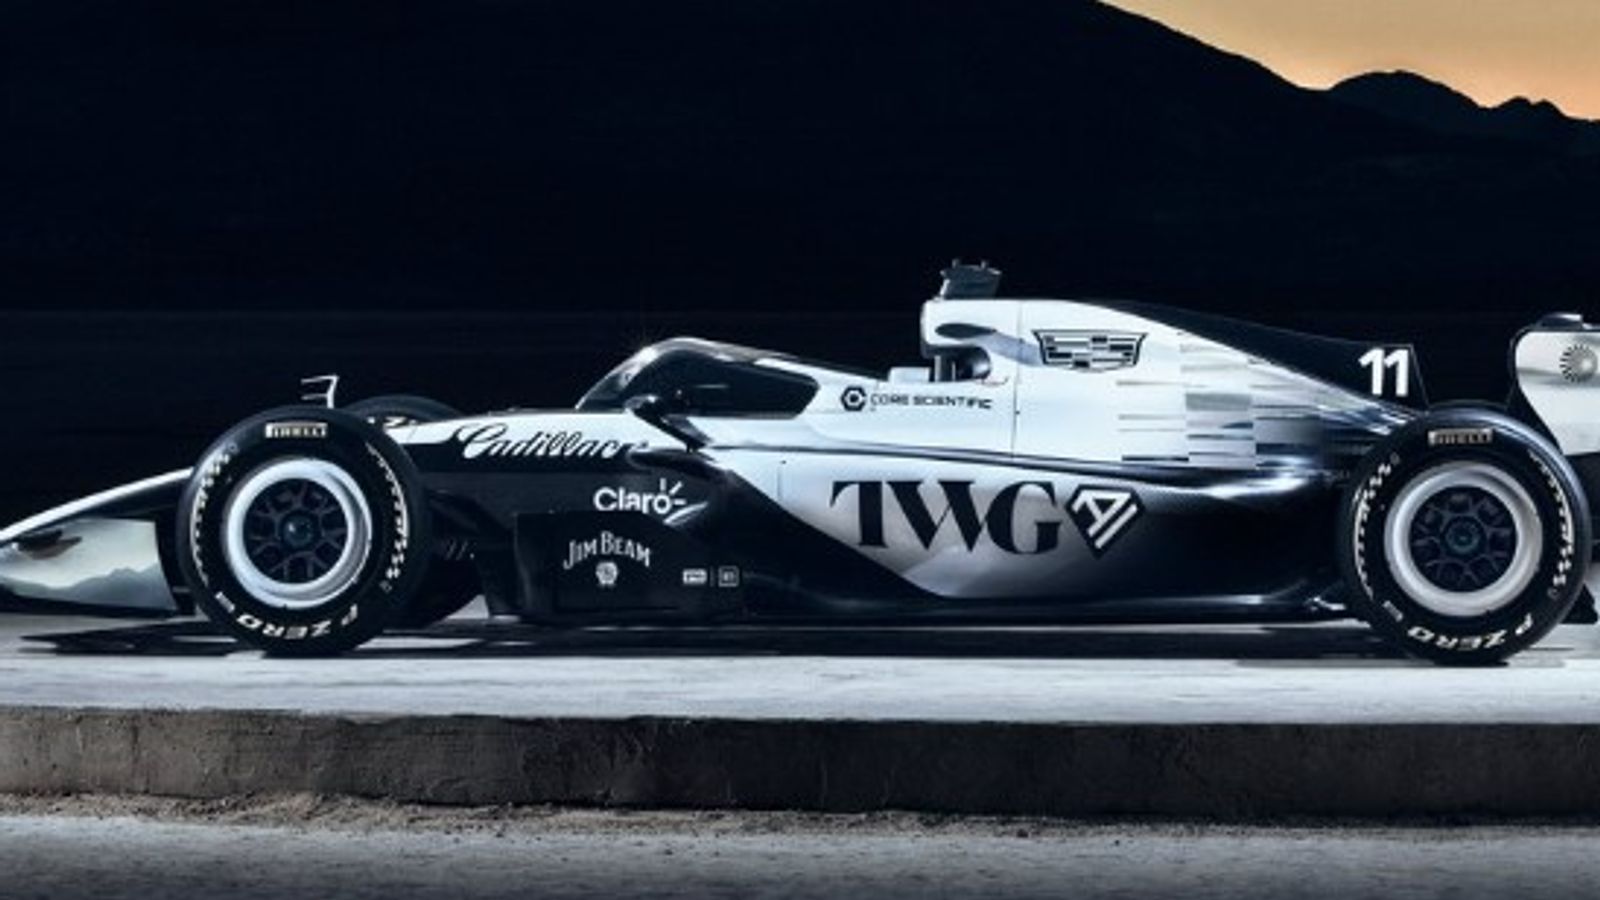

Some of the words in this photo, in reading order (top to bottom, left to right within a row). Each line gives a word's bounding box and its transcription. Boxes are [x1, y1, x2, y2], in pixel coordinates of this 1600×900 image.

[1358, 347, 1409, 396] 11
[870, 393, 909, 406] CORE
[913, 395, 993, 410] SCIENTIFIC
[450, 422, 632, 459] Cadillac
[593, 486, 672, 514] Claro
[830, 480, 1062, 555] TWG
[563, 538, 598, 570] JIM
[600, 530, 651, 568] BEAM
[235, 613, 332, 640] ZERO
[1407, 625, 1507, 649] ZERO
